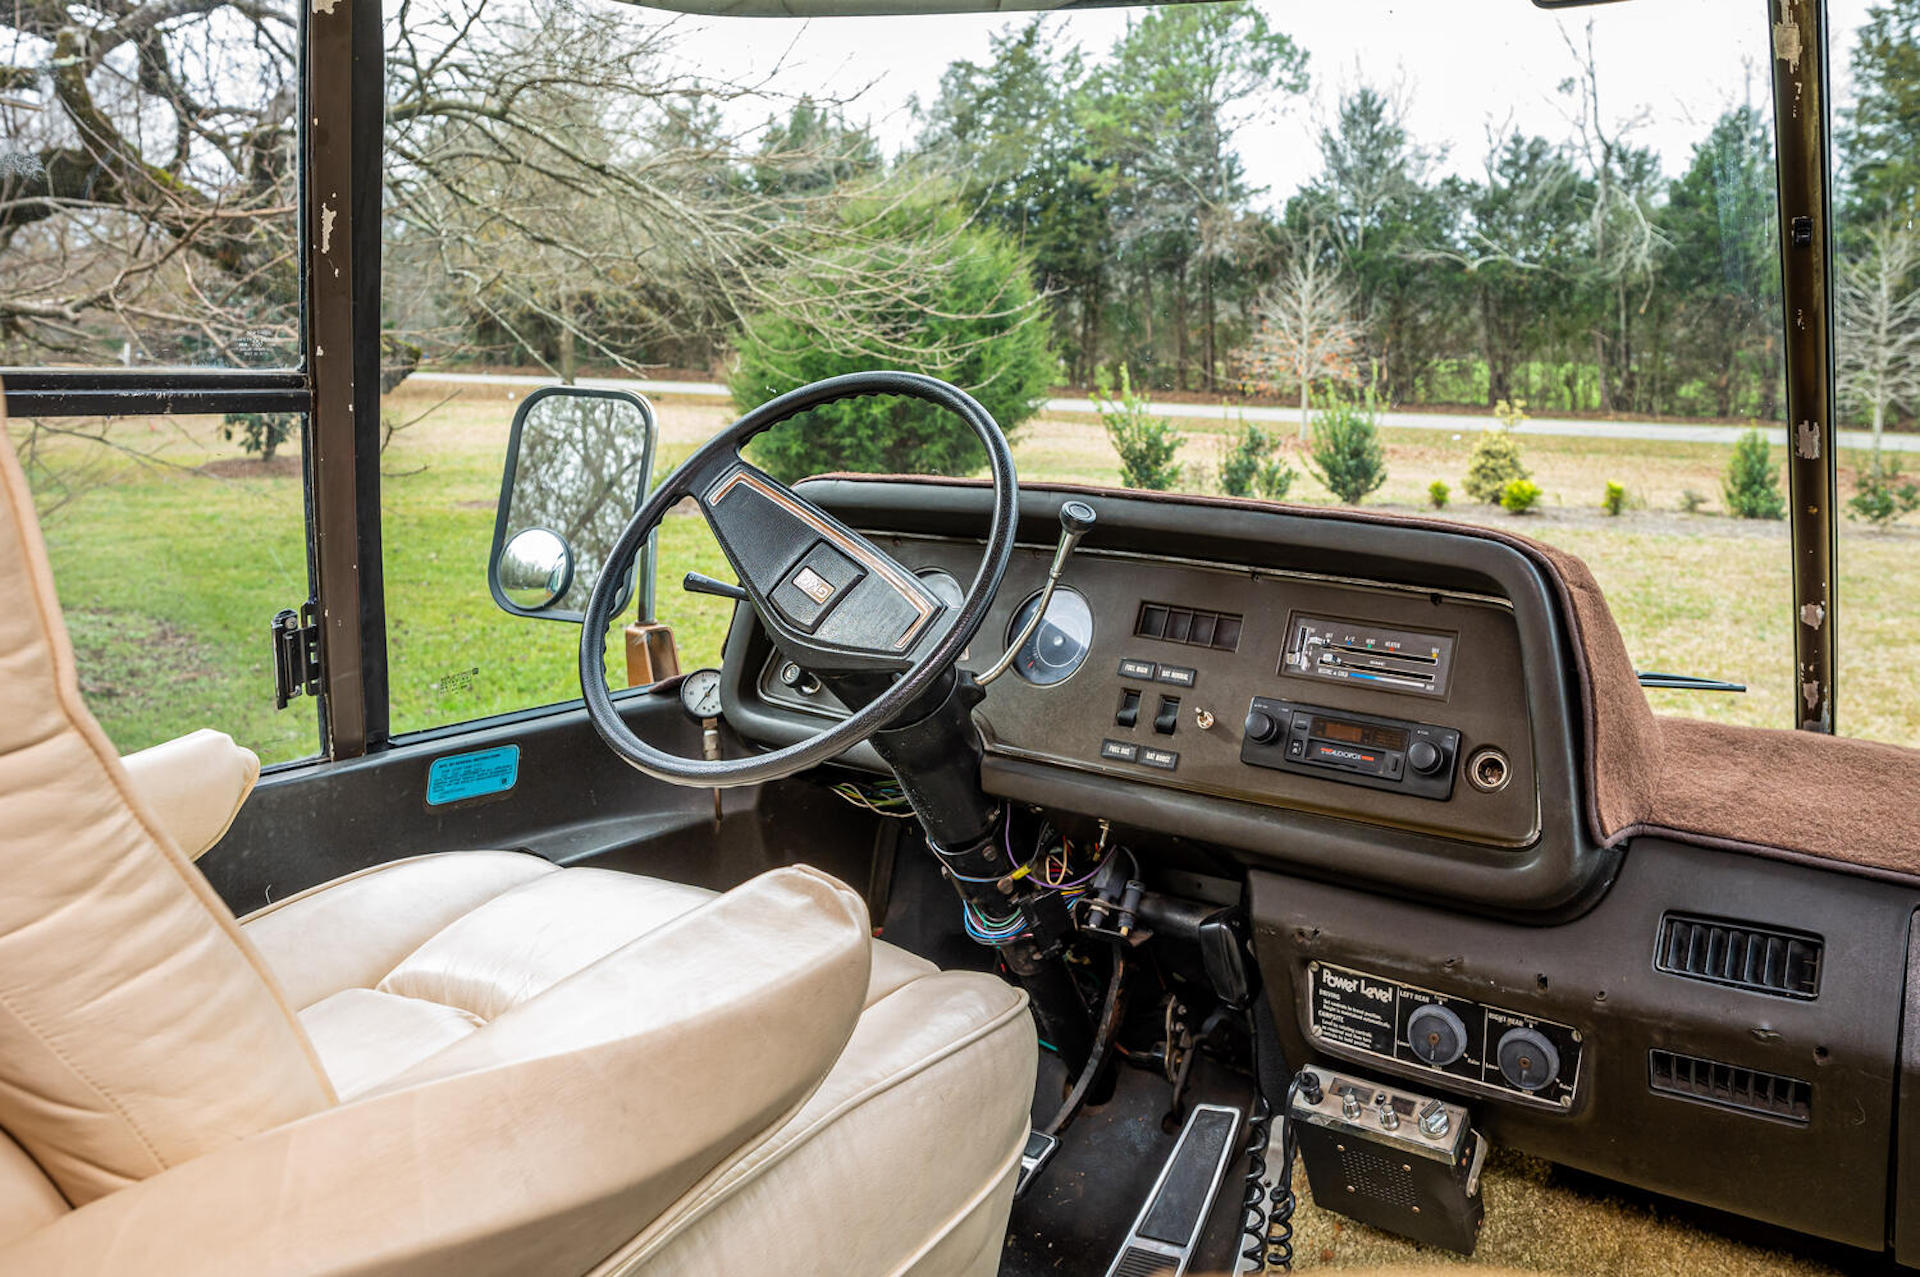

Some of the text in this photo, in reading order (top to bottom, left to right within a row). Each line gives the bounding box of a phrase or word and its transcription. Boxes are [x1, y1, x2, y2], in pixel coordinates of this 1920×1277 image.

[1322, 968, 1393, 1003] Power Level
[1399, 990, 1415, 1000] LEFT
[1414, 994, 1430, 1004] REAR
[1488, 1012, 1507, 1023] RIGHT
